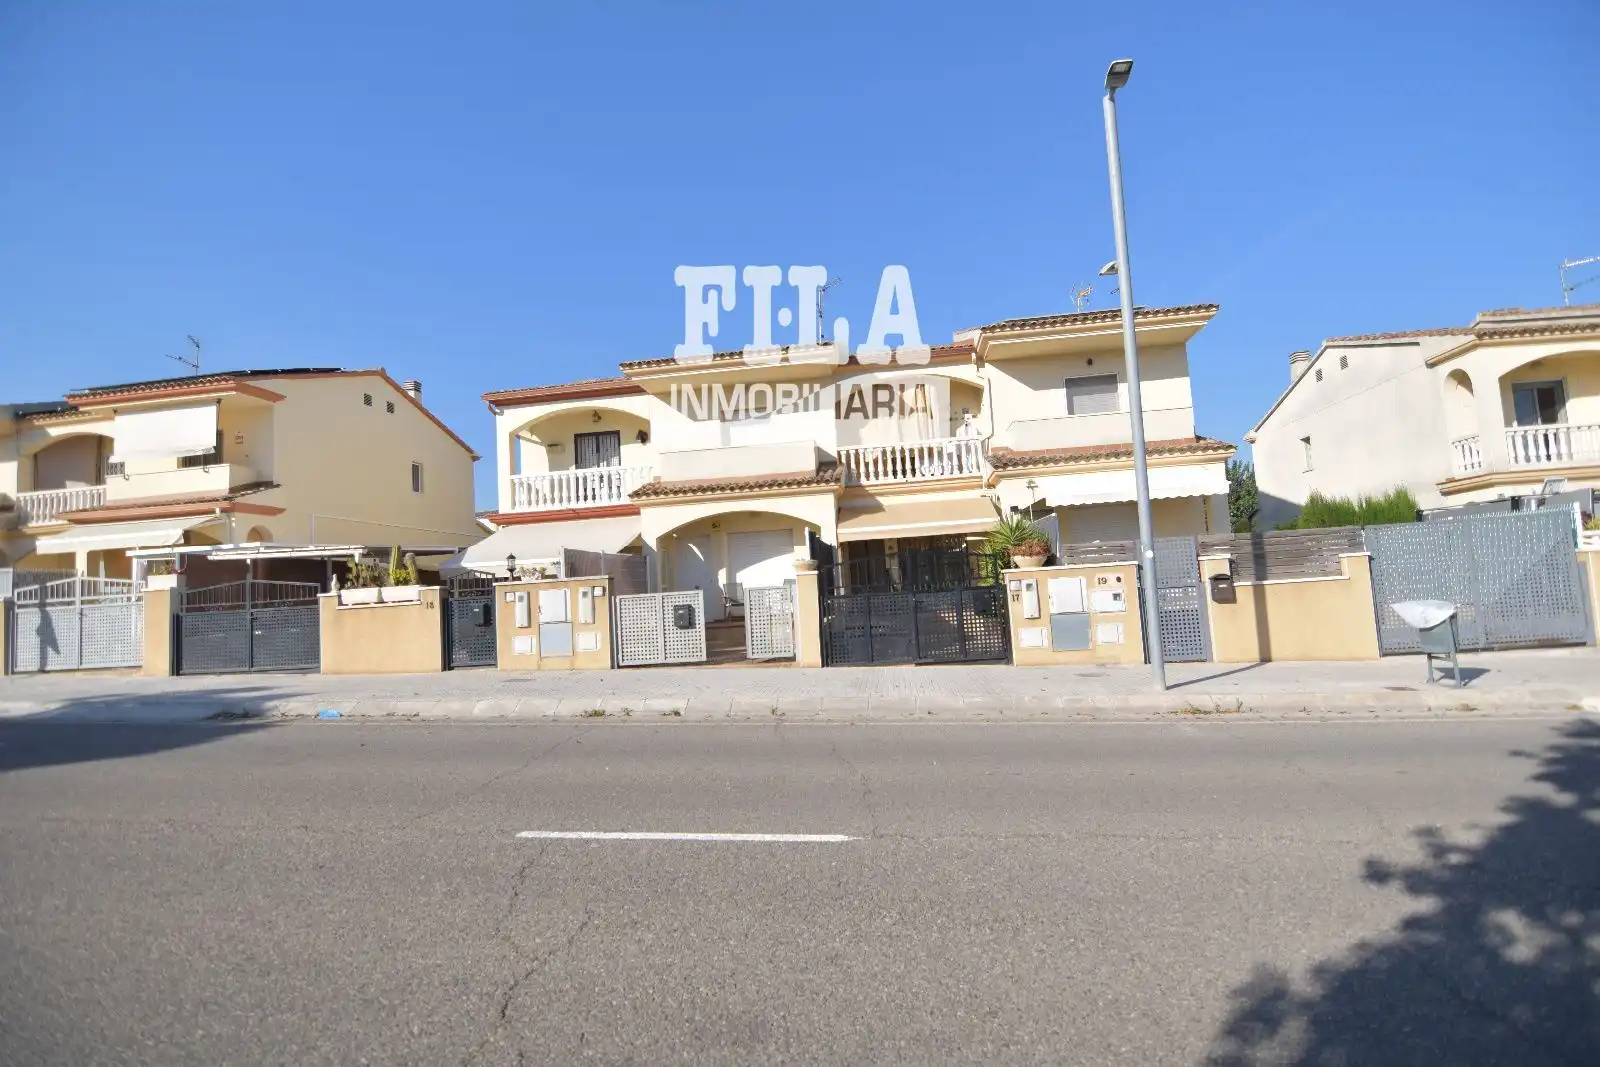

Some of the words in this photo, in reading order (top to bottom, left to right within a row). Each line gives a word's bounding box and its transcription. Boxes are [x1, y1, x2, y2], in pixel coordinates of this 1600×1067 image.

[1097, 577, 1107, 585] 19
[1011, 594, 1020, 602] 17
[426, 601, 435, 609] 18
